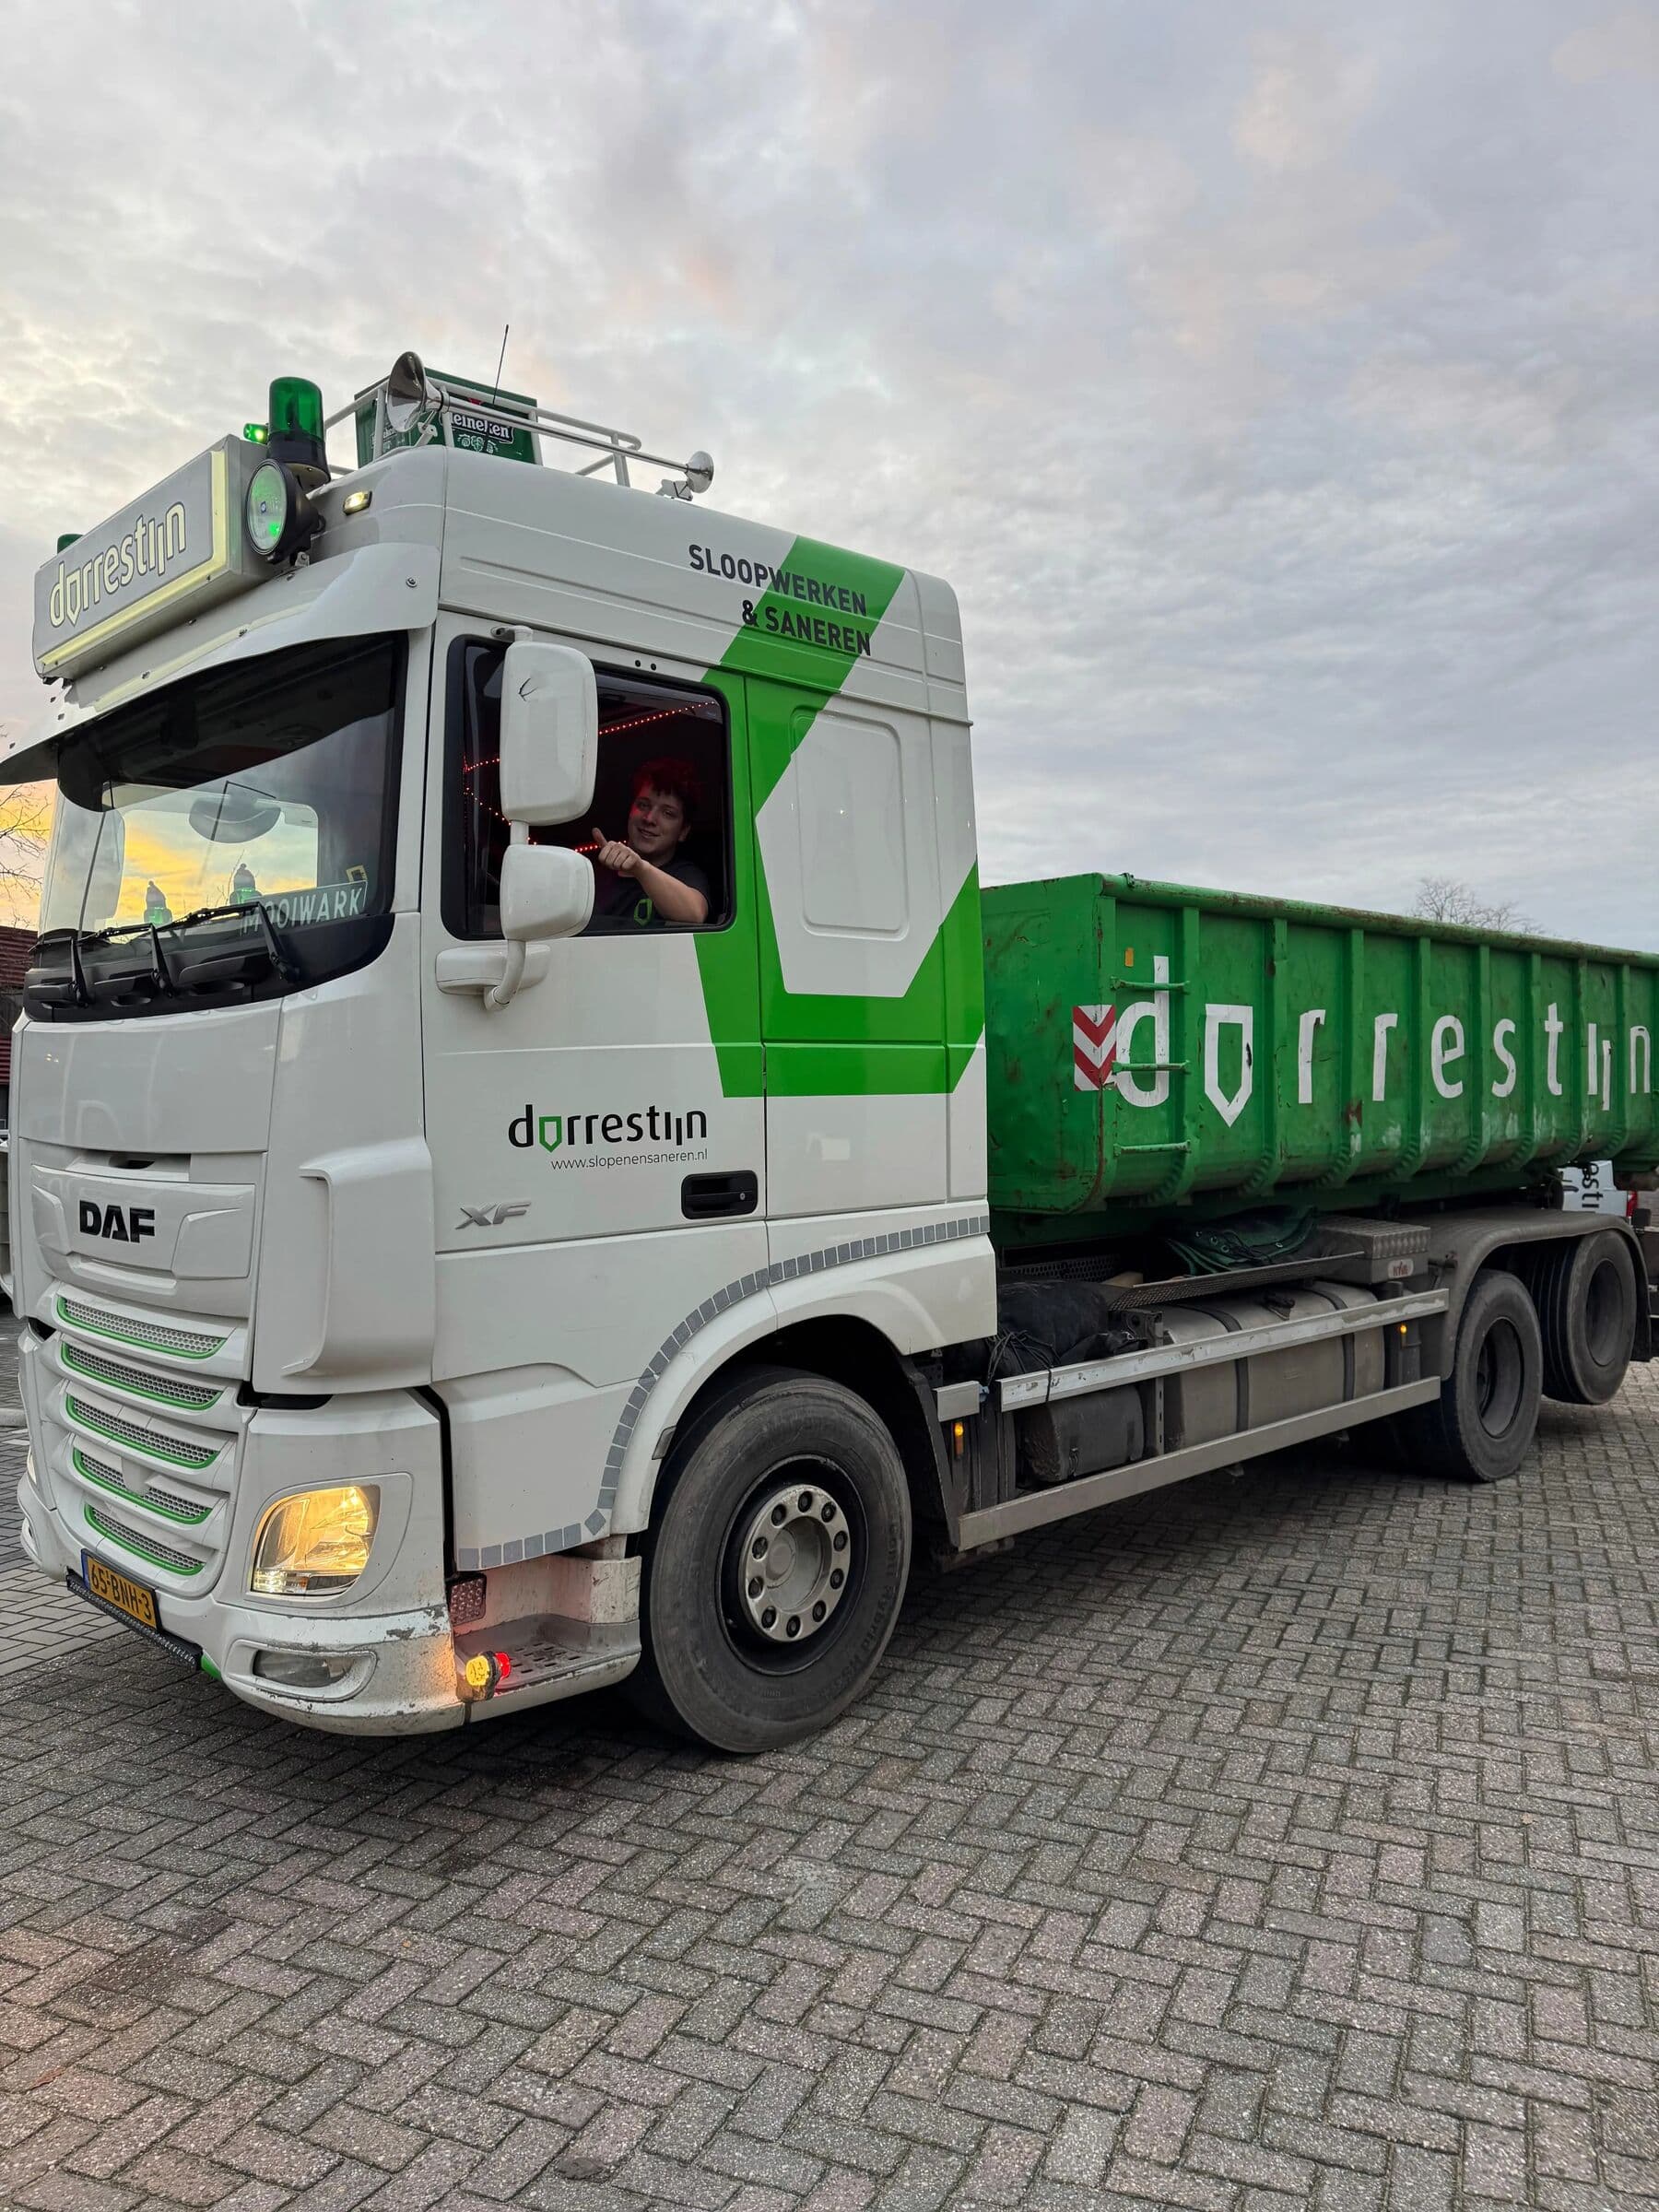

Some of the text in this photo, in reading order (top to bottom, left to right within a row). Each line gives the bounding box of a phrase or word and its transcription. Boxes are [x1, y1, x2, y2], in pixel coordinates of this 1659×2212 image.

[444, 411, 510, 439] eineken
[50, 501, 186, 628] dorrestijn
[688, 544, 867, 617] SLOOPWERKEN
[742, 600, 871, 656] & SANEREN
[241, 888, 362, 934] MOOIWARK
[1115, 955, 1651, 1127] dorrestijn
[508, 1104, 707, 1152] dorrestijn
[550, 1148, 708, 1170] www.slopenensaneren.nl
[79, 1199, 155, 1243] DAF
[454, 1202, 531, 1230] XF
